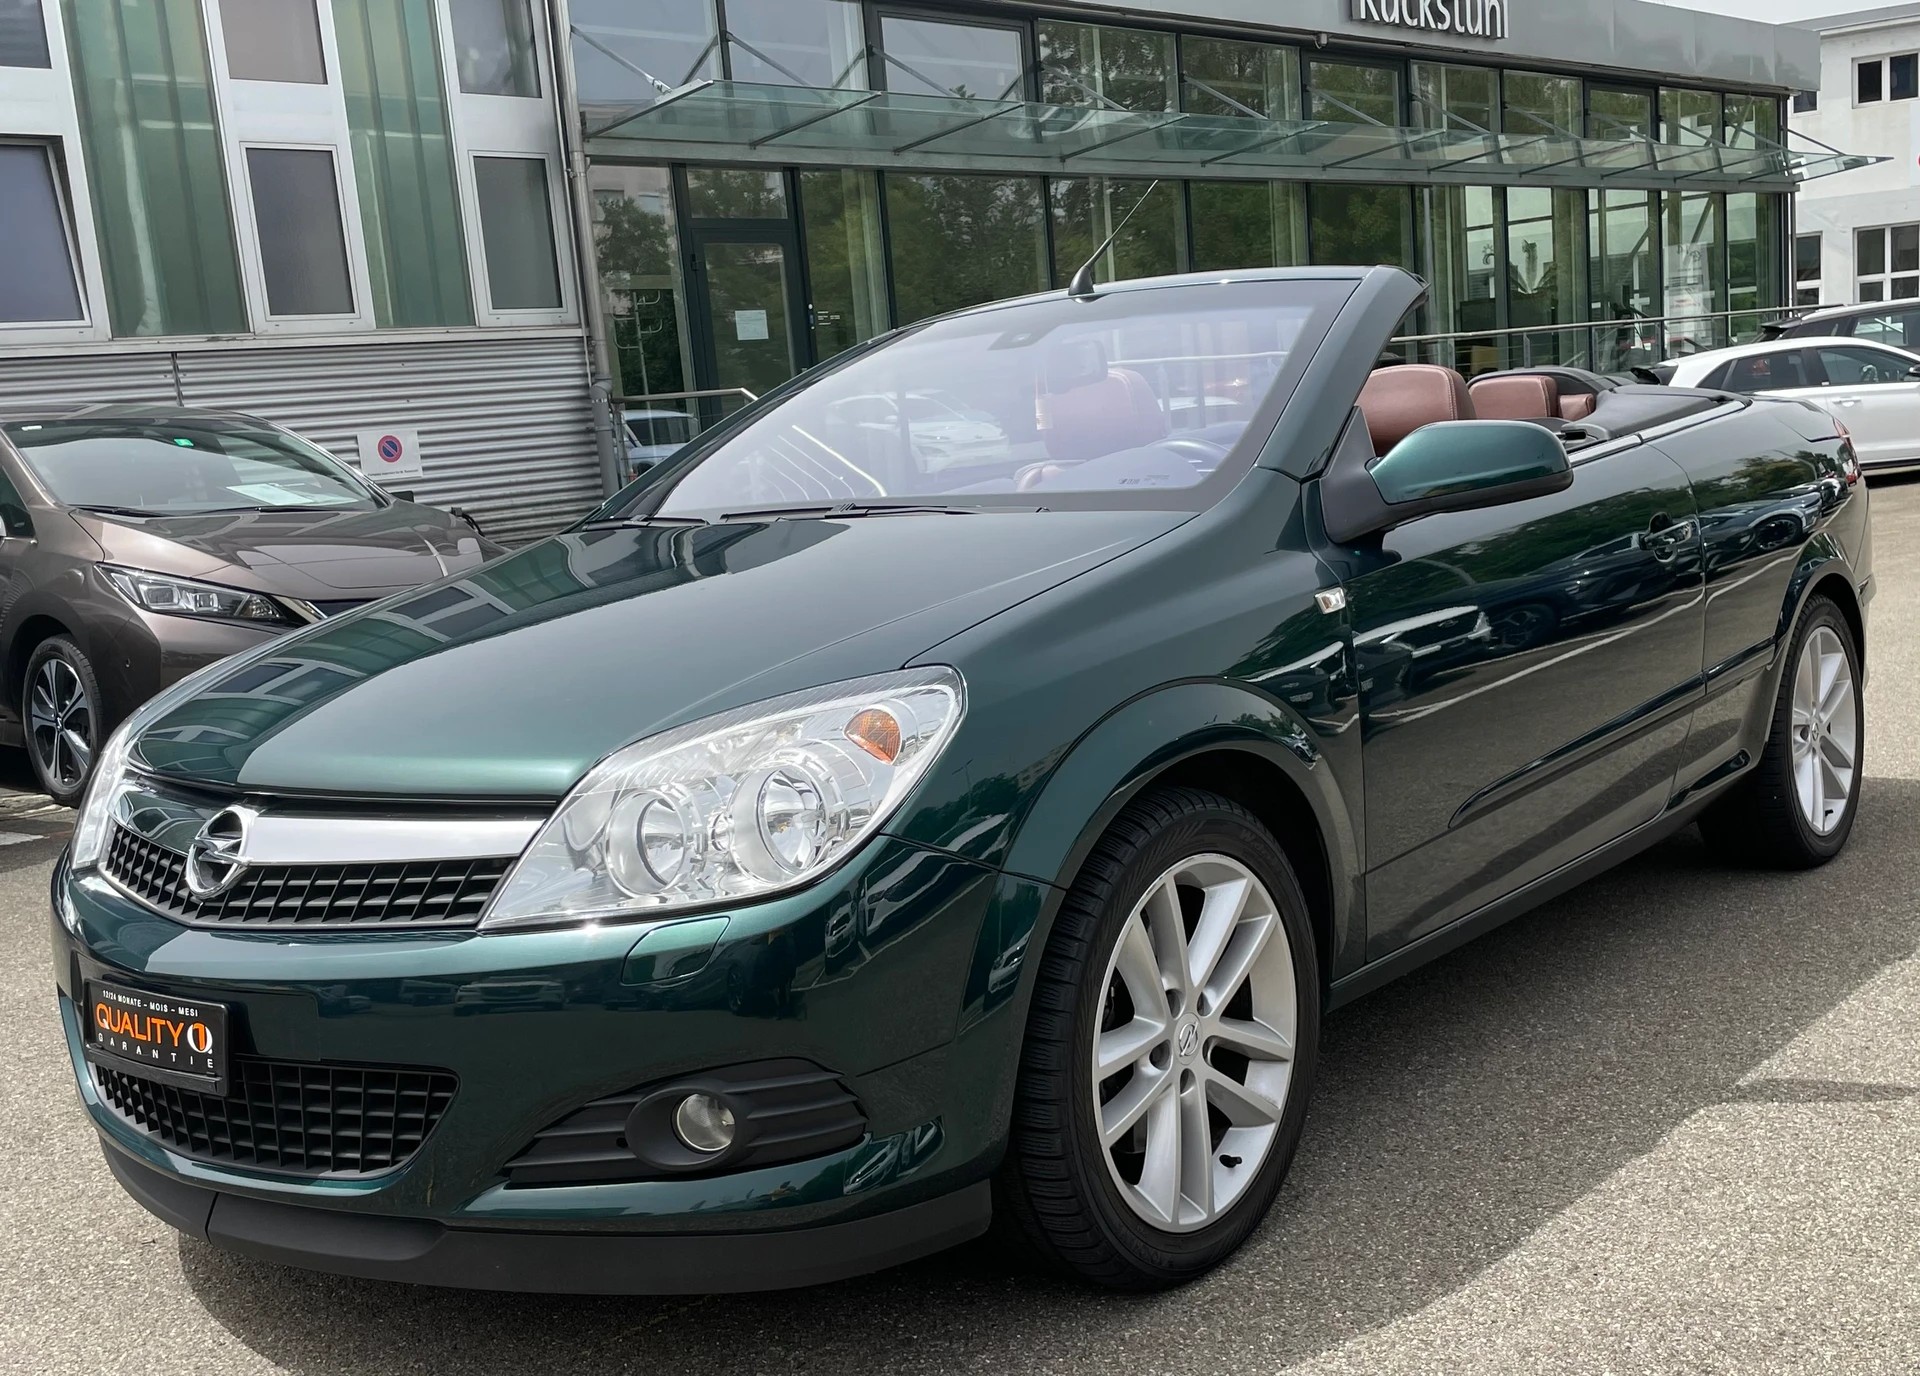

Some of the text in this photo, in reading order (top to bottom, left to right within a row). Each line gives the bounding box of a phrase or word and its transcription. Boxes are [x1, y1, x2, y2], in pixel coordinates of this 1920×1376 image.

[102, 990, 117, 1001] 12/24
[117, 994, 142, 1008] MONATE
[149, 1001, 168, 1013] MOIS
[178, 1006, 199, 1017] MESI
[96, 1003, 184, 1047] QUALITY
[98, 1032, 214, 1069] GARANTIE
